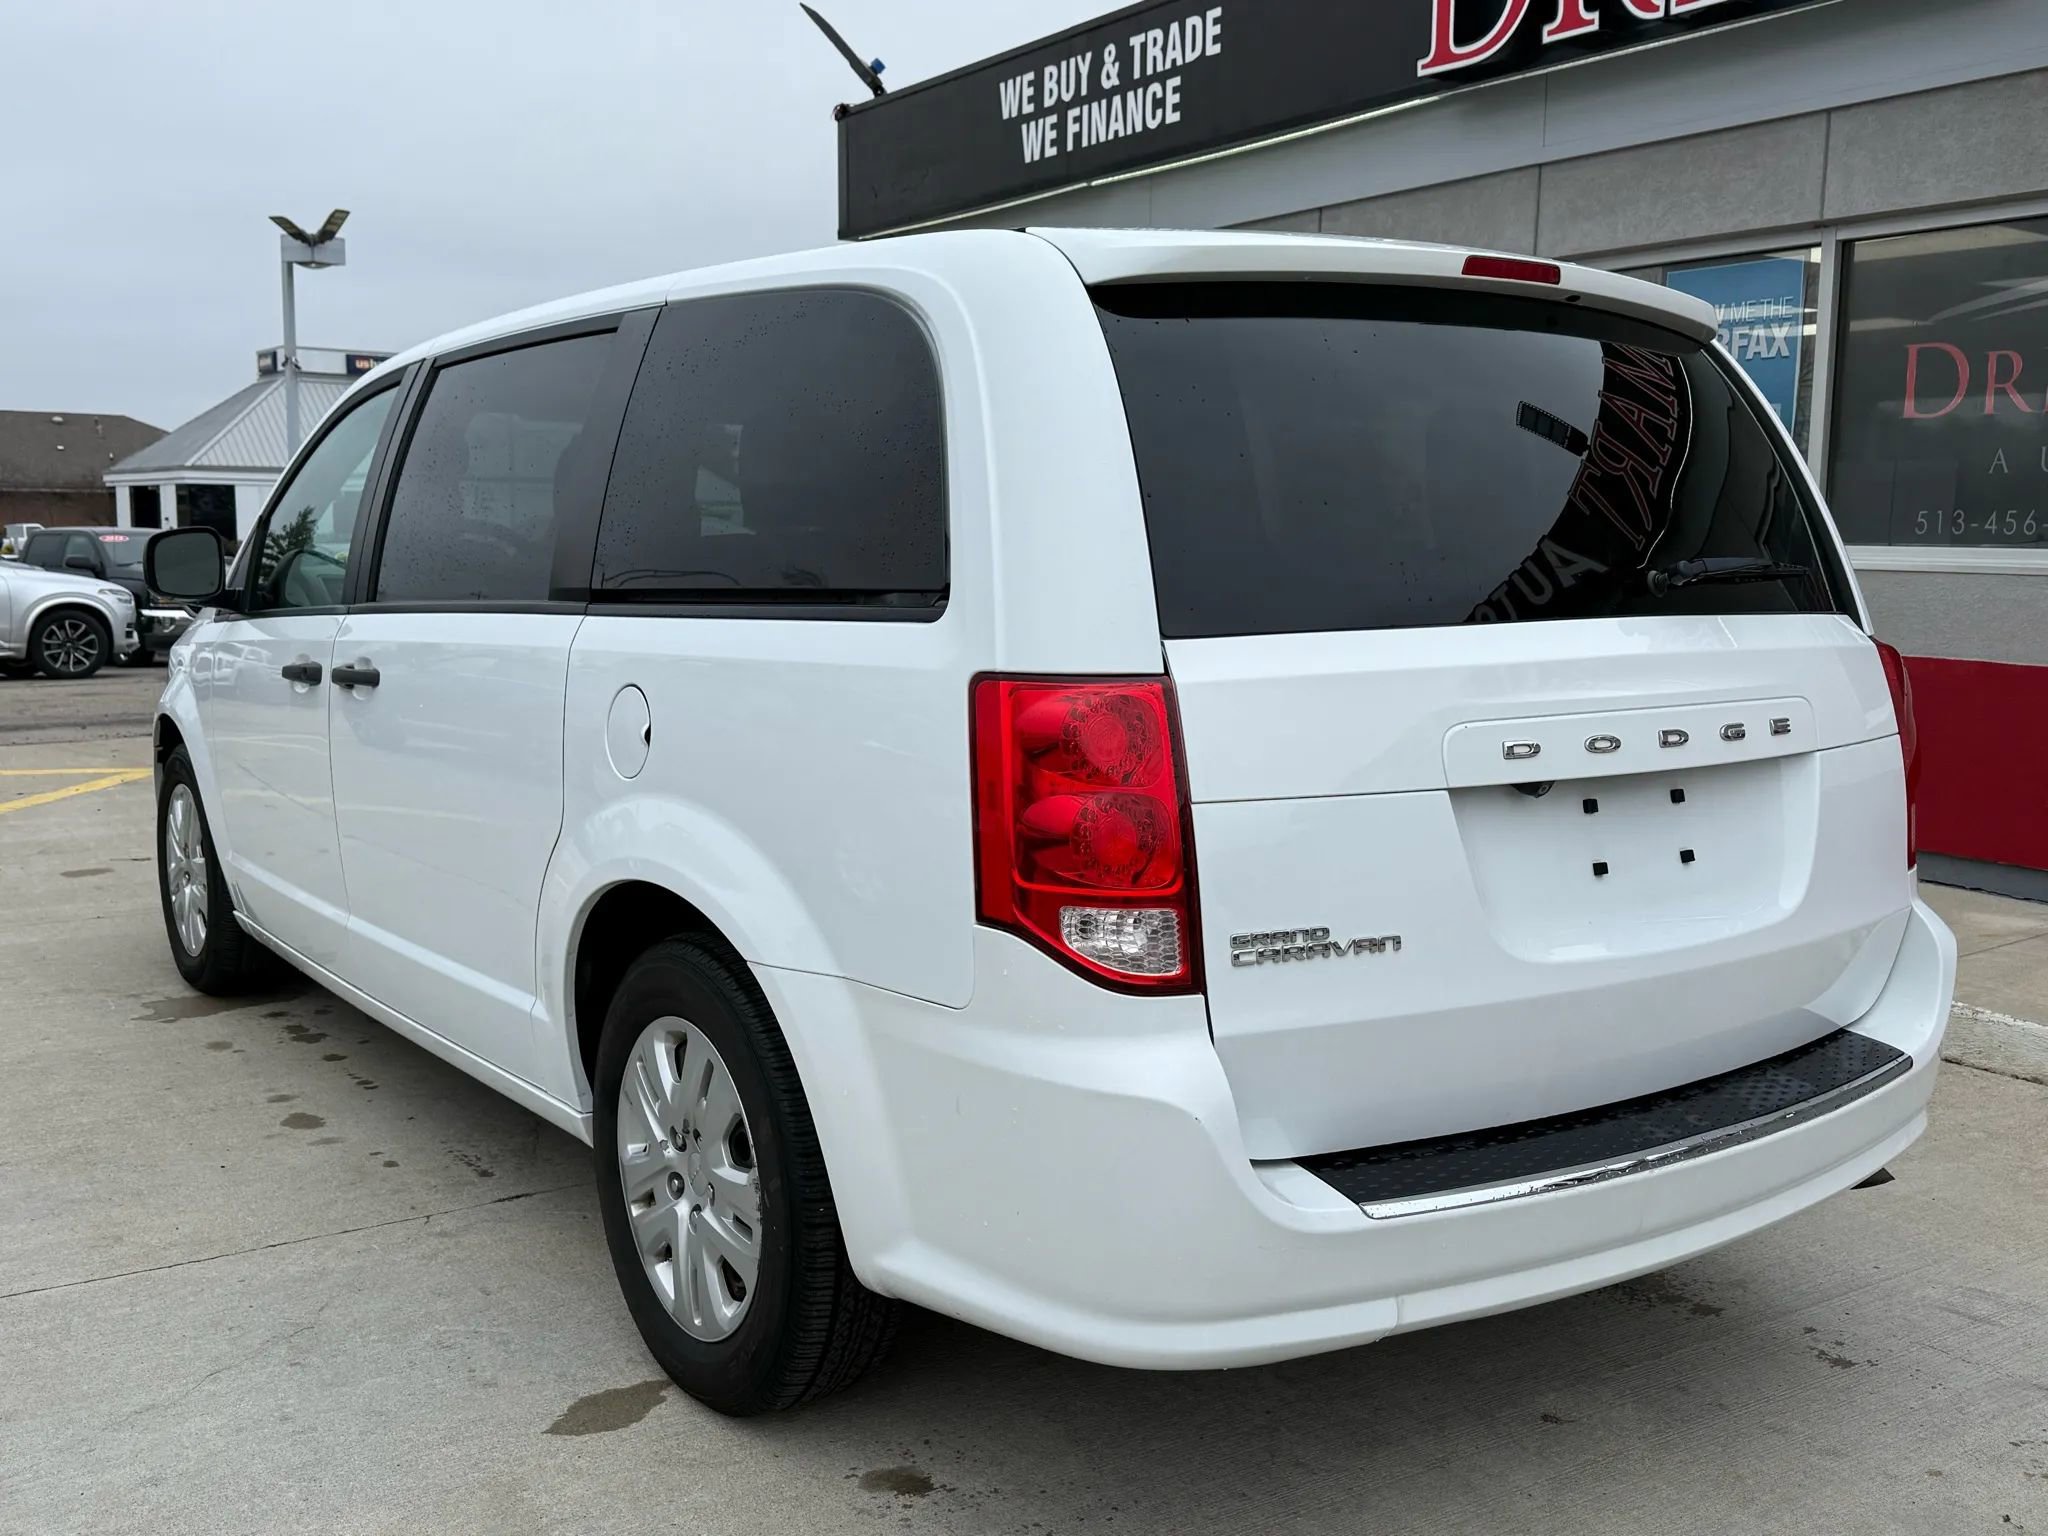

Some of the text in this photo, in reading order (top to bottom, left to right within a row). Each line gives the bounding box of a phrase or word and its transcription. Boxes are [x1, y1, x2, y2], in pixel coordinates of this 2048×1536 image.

[1000, 6, 1222, 120] WE BUY & TRADE
[1021, 75, 1181, 164] WE FINANCE
[1730, 300, 1757, 323] ME
[1760, 296, 1794, 321] THE
[1900, 341, 2048, 419] DR
[1501, 717, 1792, 760] DODGE
[1230, 926, 1330, 949] GRAND
[1231, 935, 1402, 967] CARAVAN
